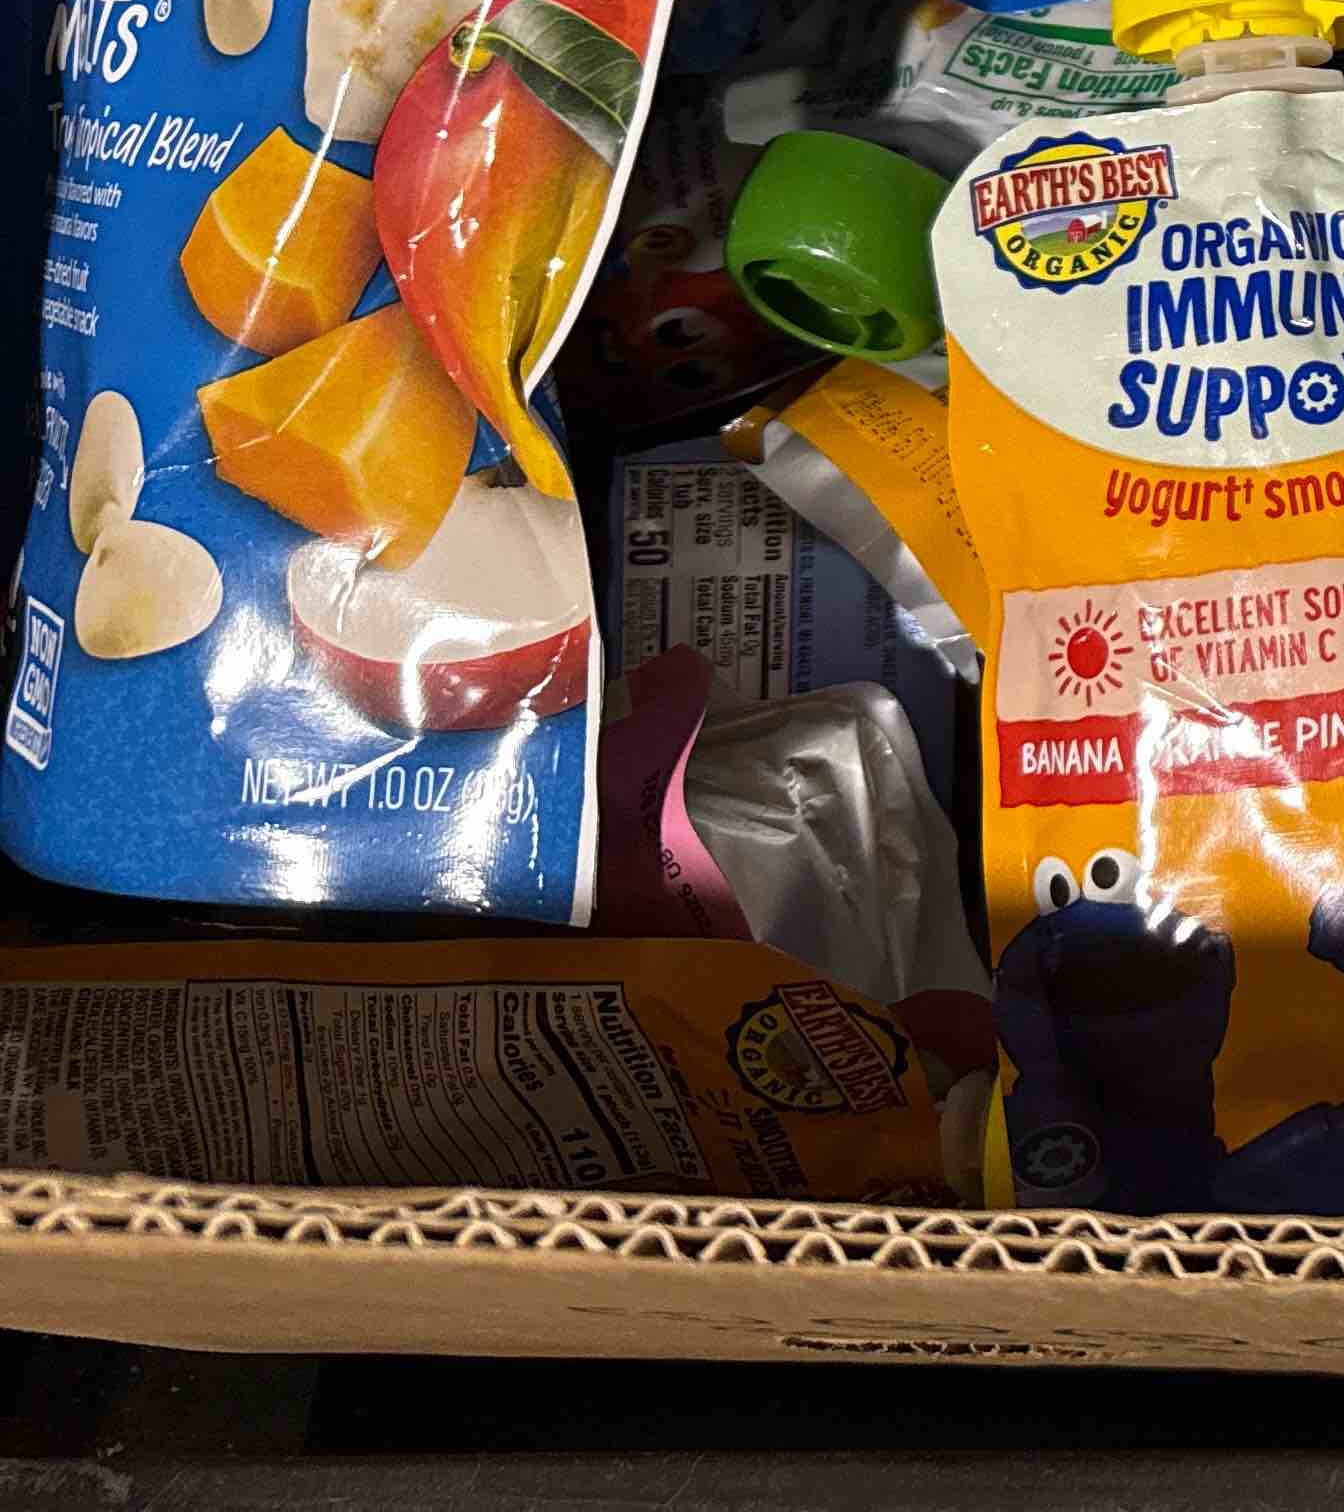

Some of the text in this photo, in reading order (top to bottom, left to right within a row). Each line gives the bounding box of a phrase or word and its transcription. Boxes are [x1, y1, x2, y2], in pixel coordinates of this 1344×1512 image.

[962, 45, 1051, 89] Facts
[149, 116, 243, 173] Blend
[976, 148, 1171, 229] EARTH'S BEST
[1006, 211, 1142, 278] ORGANIC
[1138, 591, 1291, 641] EXCELLENT
[1196, 633, 1307, 679] VITAMIN
[1022, 738, 1122, 776] BANANA
[741, 1013, 825, 1106] ORGANIC
